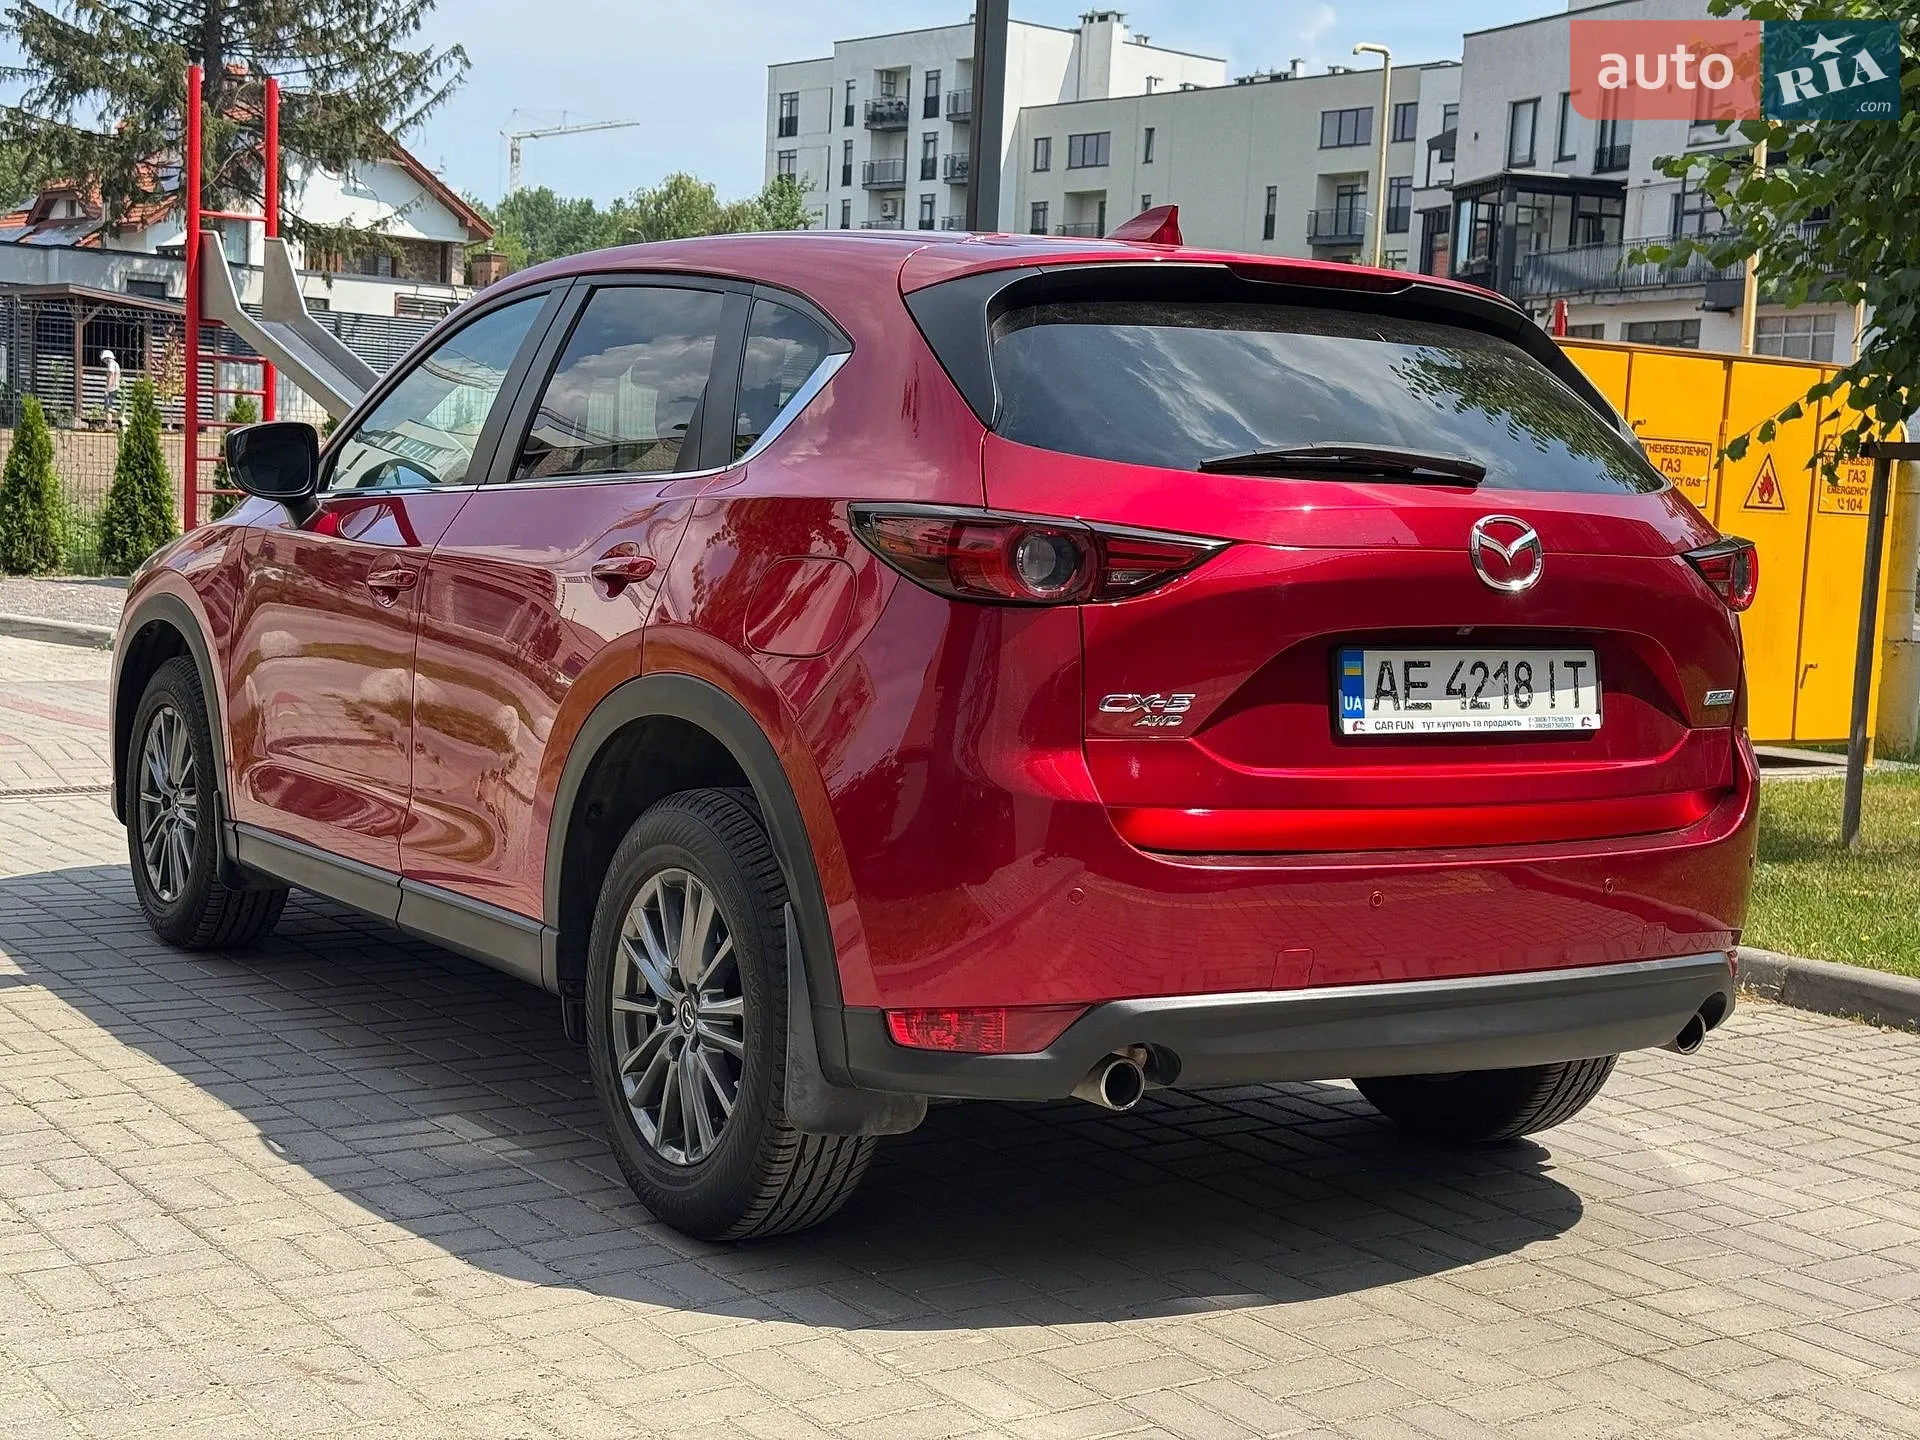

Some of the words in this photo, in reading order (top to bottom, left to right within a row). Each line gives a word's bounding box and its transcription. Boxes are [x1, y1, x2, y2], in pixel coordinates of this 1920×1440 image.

[1660, 457, 1682, 473] ГАЗ
[1847, 469, 1867, 483] ГАЗ
[1826, 484, 1869, 496] EMERGENCY
[1846, 498, 1863, 511] 104
[1372, 660, 1433, 711] AE
[1445, 660, 1534, 710] 4218
[1549, 660, 1588, 709] IT
[1099, 693, 1196, 713] CX-5
[1344, 695, 1363, 711] UA
[1133, 715, 1184, 727] AWD
[1374, 720, 1394, 731] CAR
[1395, 720, 1415, 730] FUN
